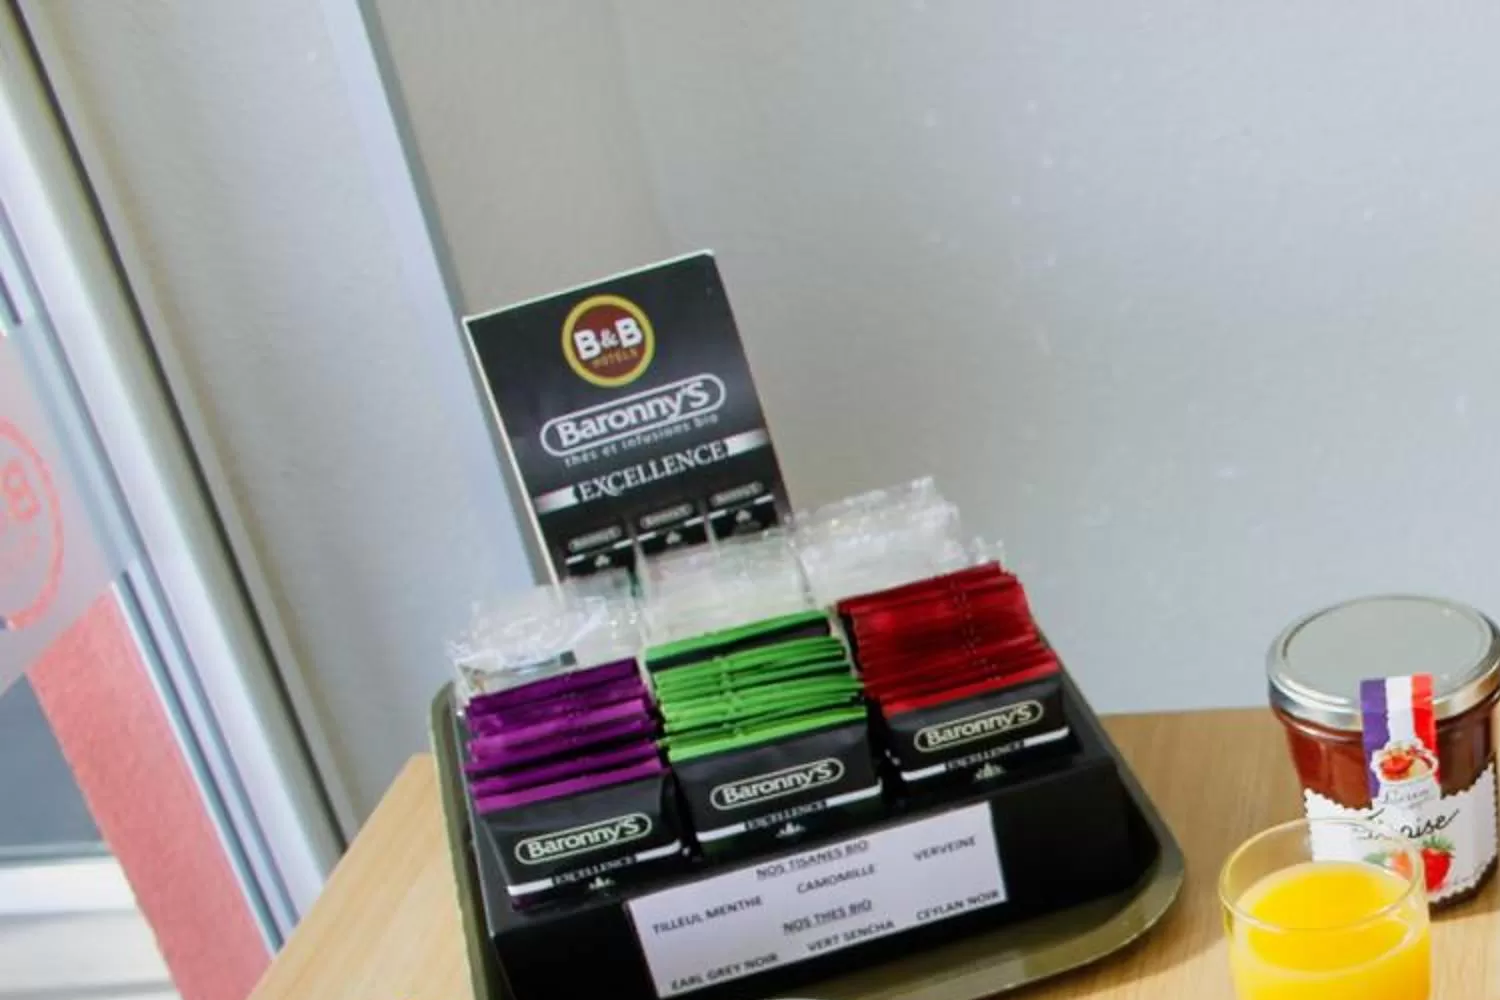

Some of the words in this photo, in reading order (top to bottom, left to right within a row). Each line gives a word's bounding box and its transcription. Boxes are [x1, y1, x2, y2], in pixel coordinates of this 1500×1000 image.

[573, 317, 643, 361] B&B
[578, 440, 727, 502] EXCELLENCE
[789, 848, 843, 875] TISANES
[845, 840, 870, 856] BIO
[913, 836, 977, 862] VERVEINE
[796, 863, 876, 894] CAMOMILLE
[652, 912, 704, 936] TILLEUL
[705, 896, 764, 920] MENTHE
[783, 918, 812, 935] NOS
[848, 899, 873, 917] BIO
[916, 900, 965, 922] CEYLAN
[966, 889, 1000, 906] NOIR
[807, 934, 840, 952] VERT
[843, 920, 896, 942] SENCHA
[671, 974, 705, 990] EARL
[706, 963, 742, 980] GREY
[743, 953, 779, 970] NOIR
